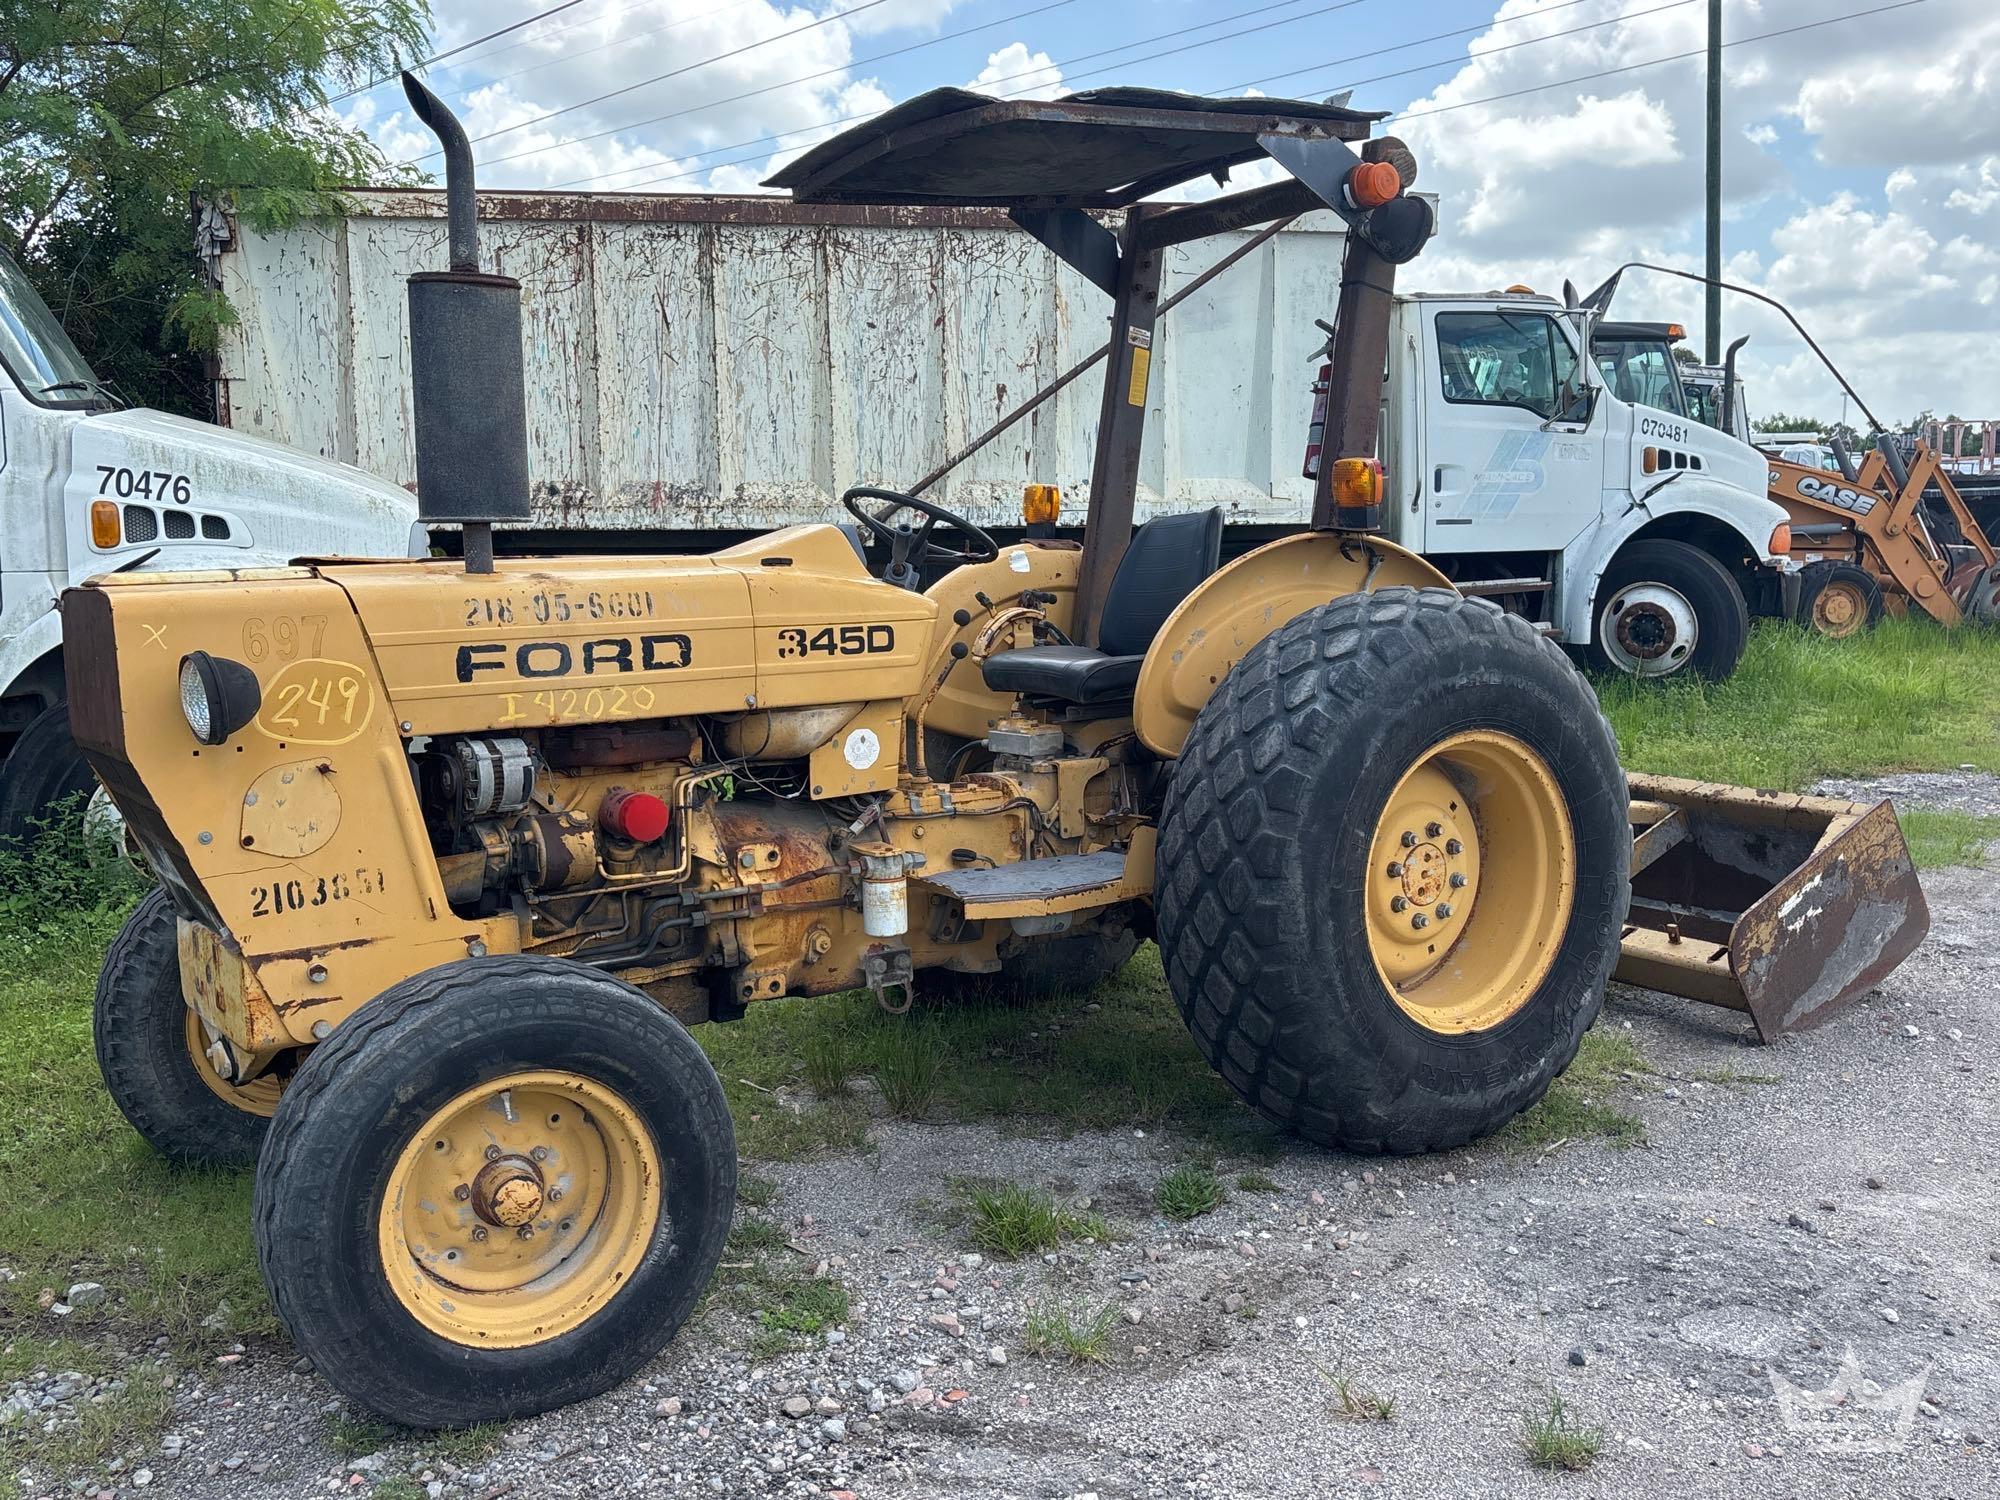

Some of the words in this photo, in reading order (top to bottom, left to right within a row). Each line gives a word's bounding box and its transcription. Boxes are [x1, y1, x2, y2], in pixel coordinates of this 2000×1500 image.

[1641, 417, 1688, 444] 070481
[96, 465, 191, 504] 70476
[1797, 475, 1878, 515] CASE
[241, 615, 328, 663] 697
[456, 634, 692, 683] FORD
[778, 625, 895, 659] 345D
[271, 677, 359, 728] 249
